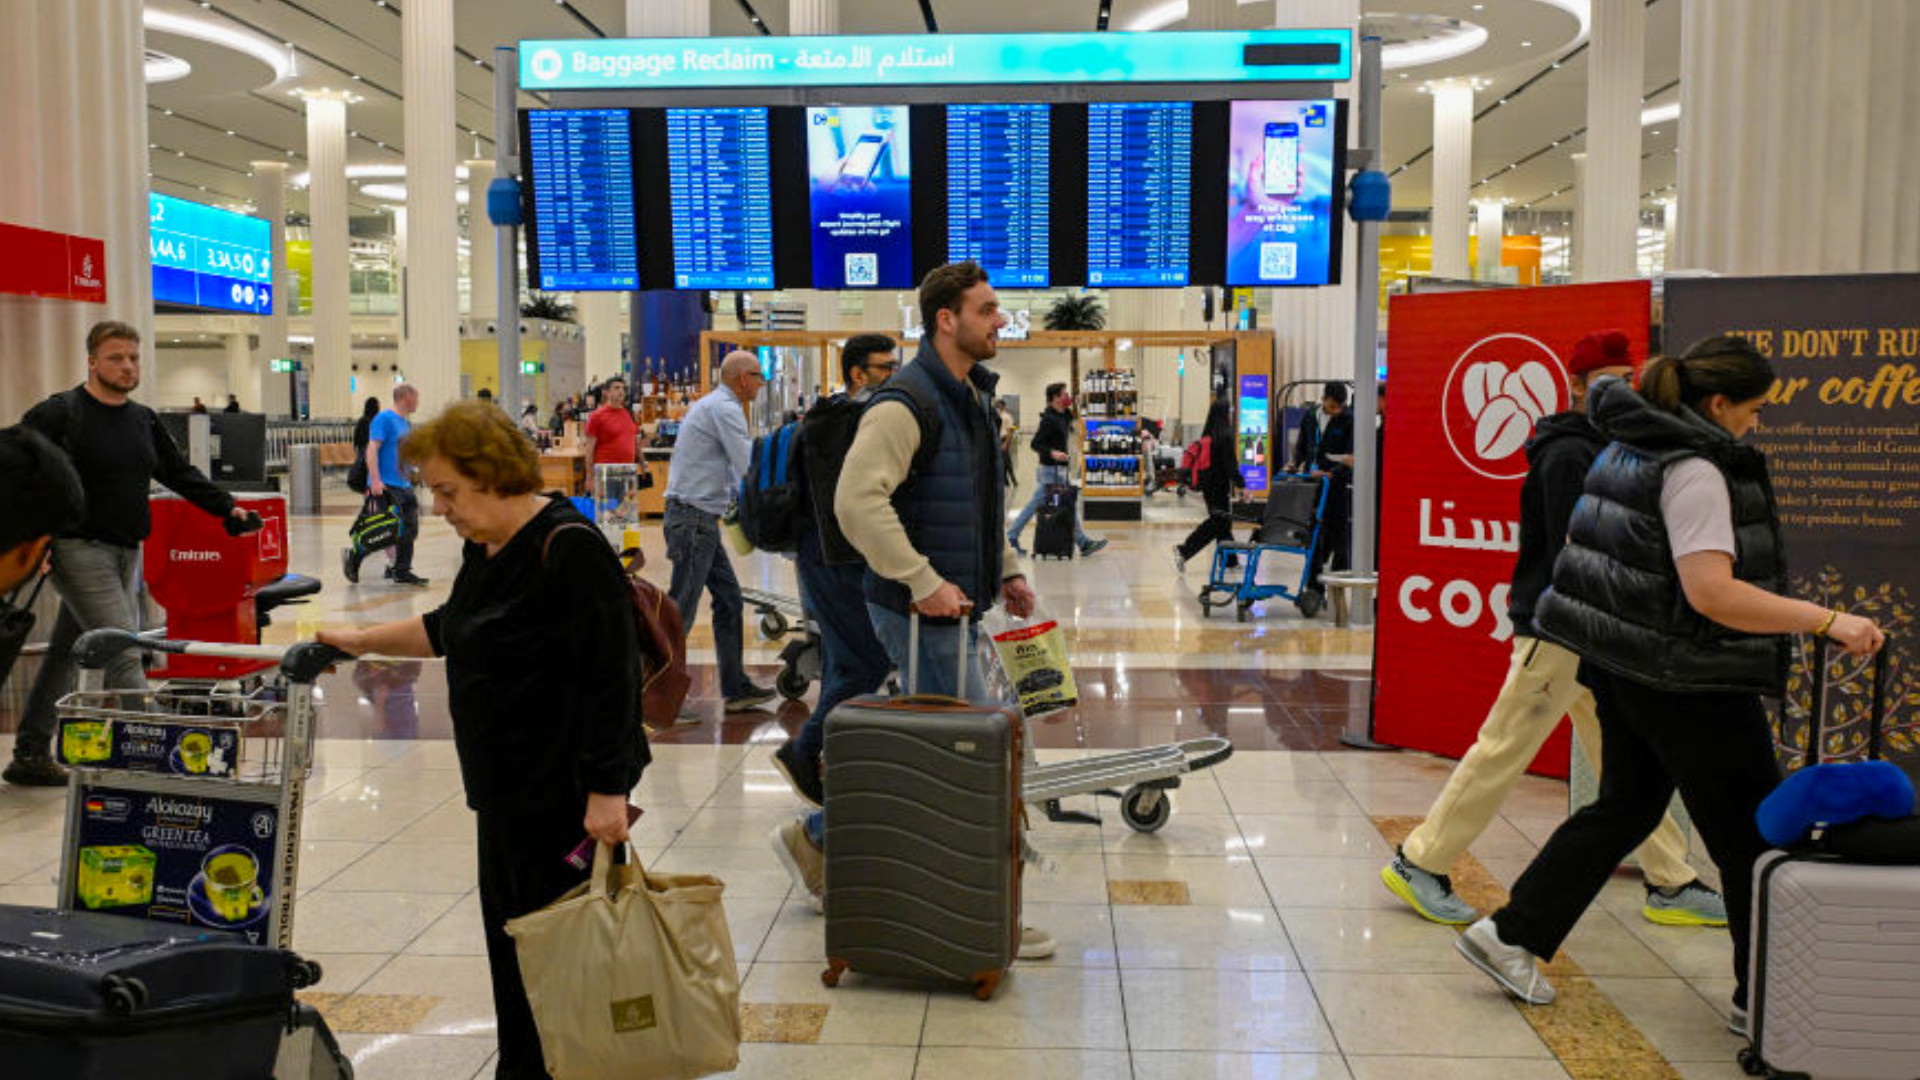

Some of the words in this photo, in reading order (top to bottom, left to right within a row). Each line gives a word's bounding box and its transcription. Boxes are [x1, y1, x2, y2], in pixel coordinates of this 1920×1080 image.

[572, 51, 676, 77] Baggage
[683, 48, 773, 70] Reclaim
[877, 45, 954, 77] استلام
[1782, 328, 1869, 358] DON'T
[1764, 376, 1810, 406] ur
[1419, 498, 1520, 553] ستا
[169, 549, 222, 562] Emirates
[1398, 574, 1514, 643] COS
[145, 796, 213, 824] Alokozay
[142, 825, 184, 842] GREEN
[186, 829, 210, 845] TEA
[282, 790, 299, 887] PASSENGER
